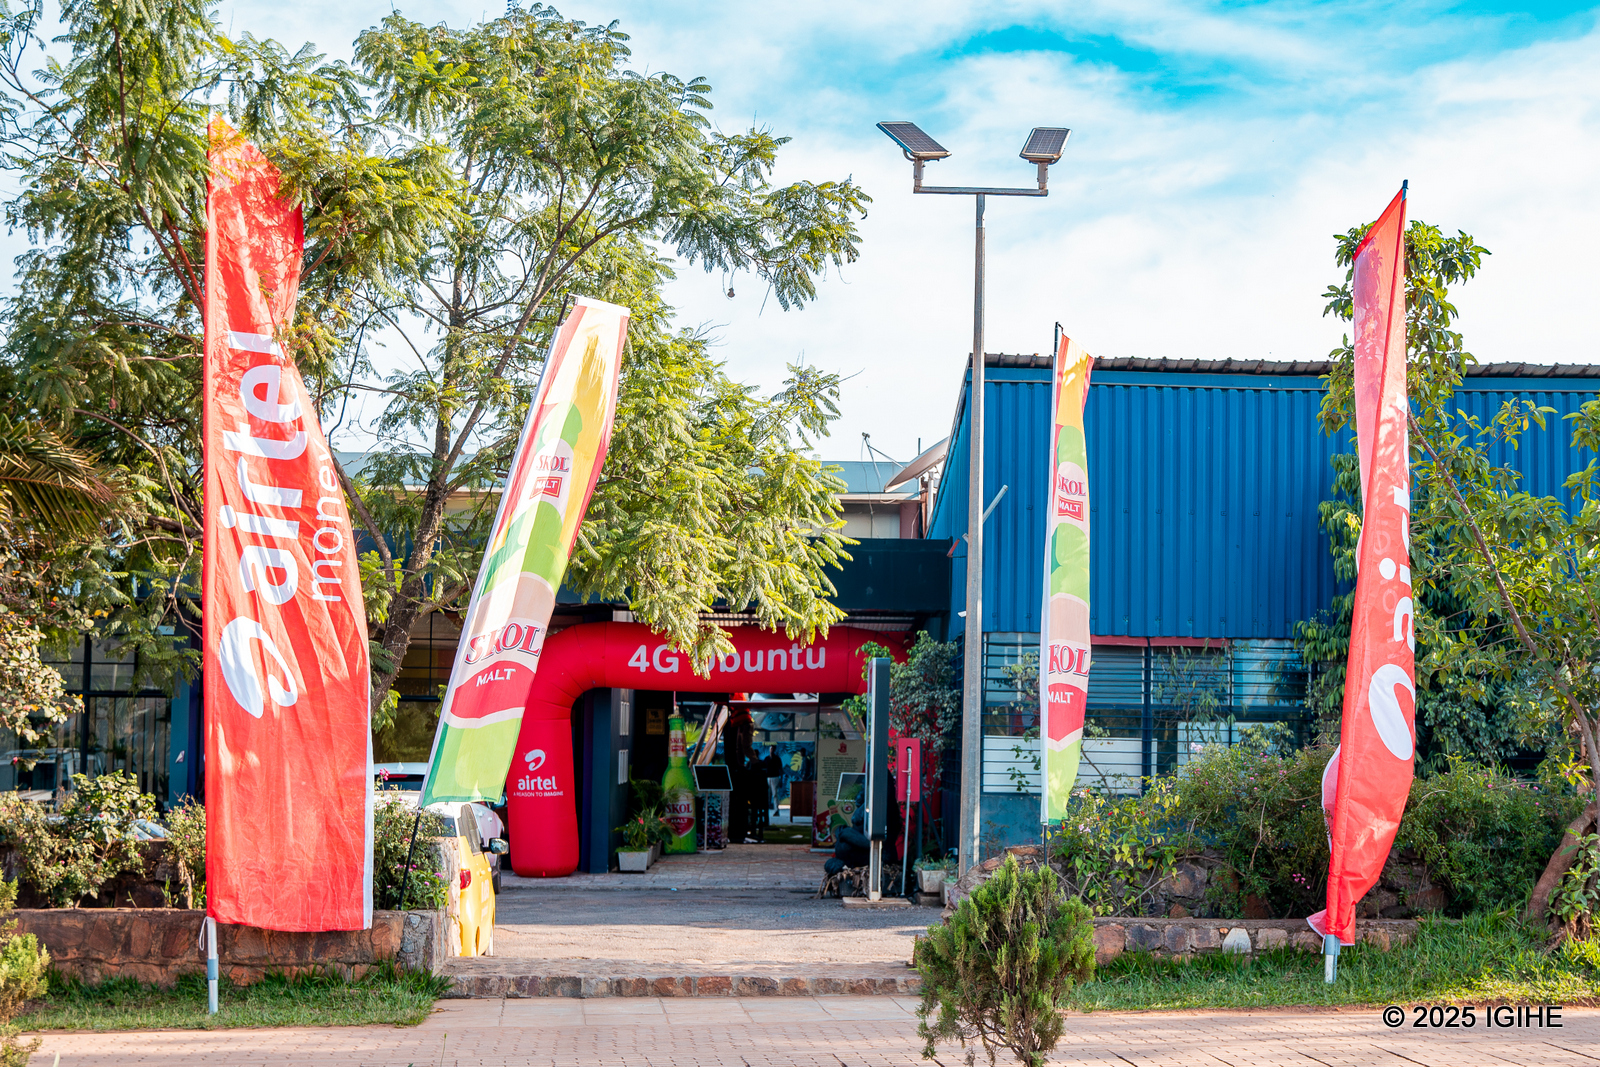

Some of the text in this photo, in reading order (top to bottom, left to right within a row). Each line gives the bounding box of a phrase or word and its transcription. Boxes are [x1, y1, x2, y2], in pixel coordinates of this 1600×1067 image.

[219, 330, 308, 606] airtel
[536, 454, 570, 473] SKOL
[1059, 501, 1080, 512] MALT
[464, 622, 542, 665] SKOL
[628, 644, 680, 673] 4G
[476, 668, 516, 687] MALT
[1048, 691, 1074, 703] MALT
[518, 775, 557, 790] airtel
[666, 803, 692, 814] SKOL
